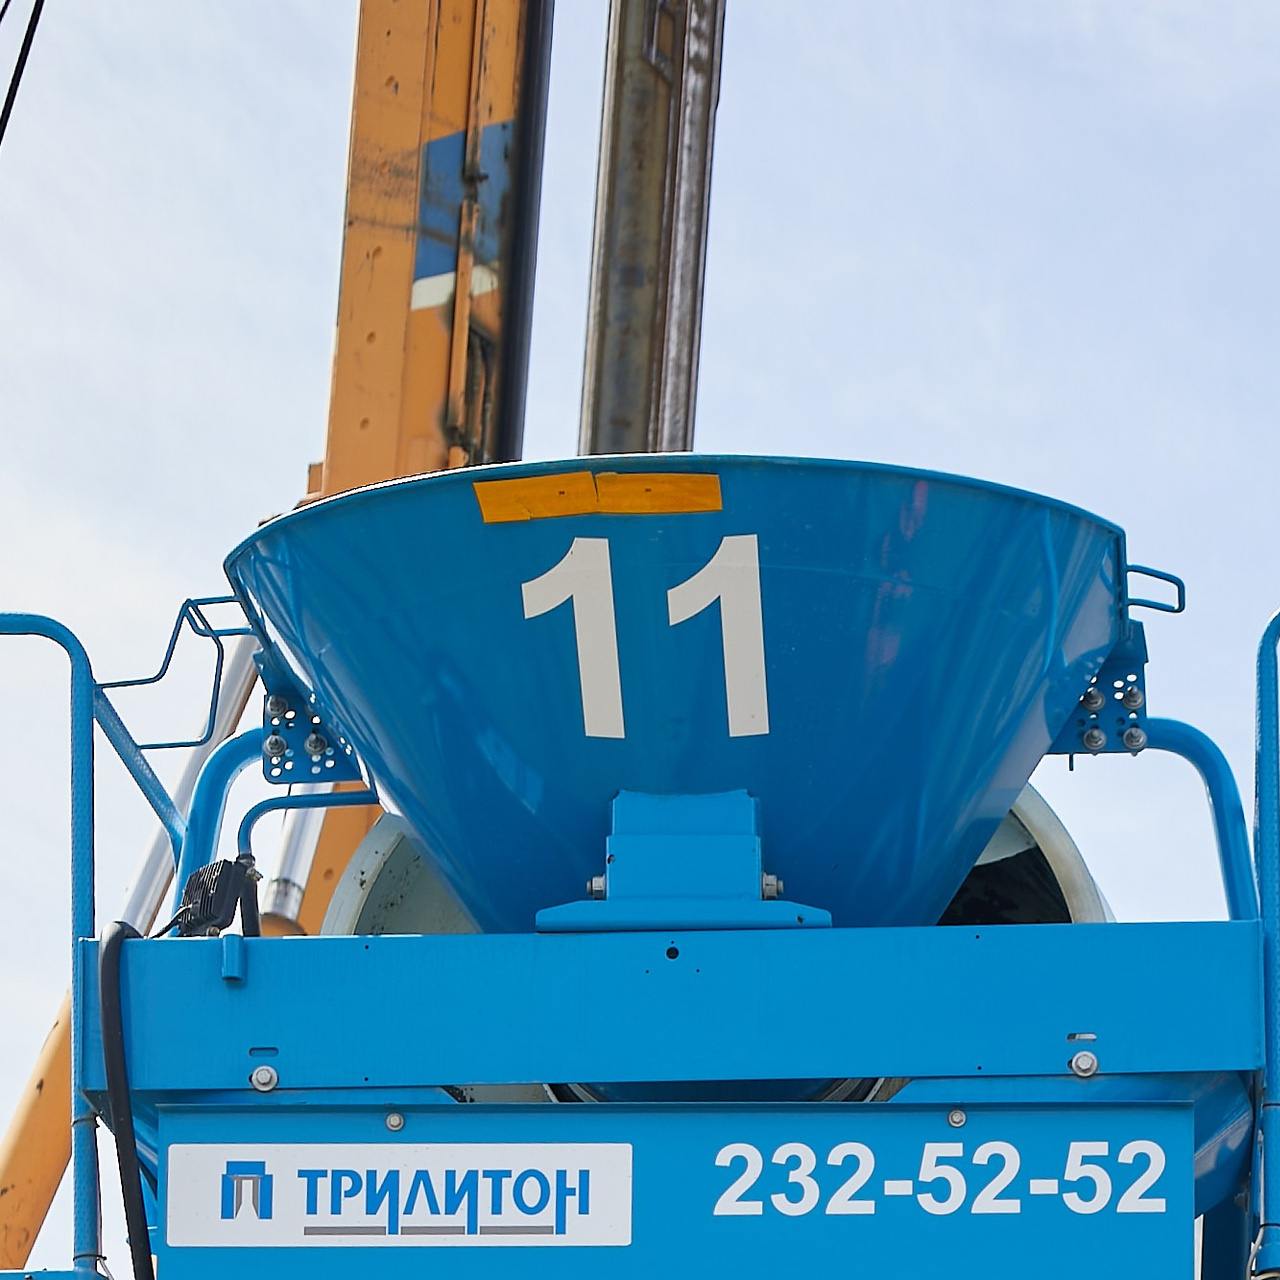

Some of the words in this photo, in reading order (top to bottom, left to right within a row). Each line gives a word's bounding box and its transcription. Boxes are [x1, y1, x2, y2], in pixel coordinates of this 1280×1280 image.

[521, 534, 770, 739] 11
[297, 1168, 590, 1236] ТРИЛИТОН
[713, 1139, 1167, 1216] 232-52-52
